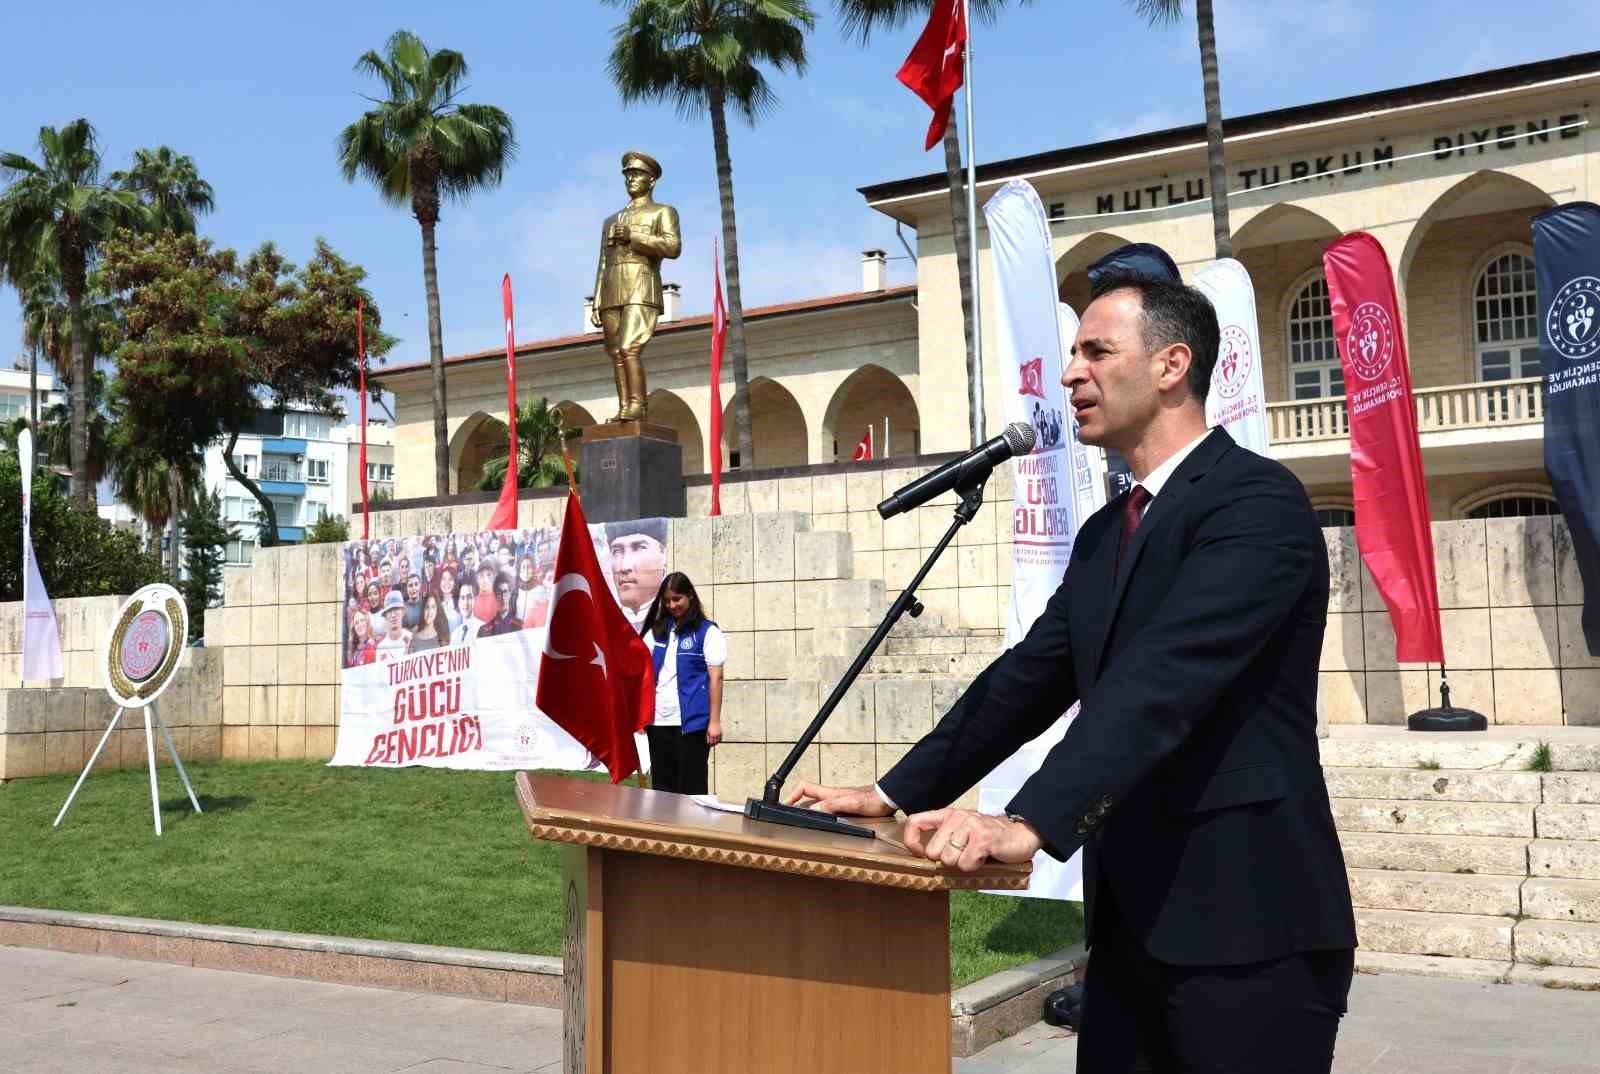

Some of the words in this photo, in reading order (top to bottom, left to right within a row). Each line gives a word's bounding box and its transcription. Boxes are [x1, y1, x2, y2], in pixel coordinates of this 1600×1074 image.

[1050, 202, 1065, 223] E
[1097, 178, 1204, 214] MUTLU
[393, 677, 461, 724] GÜCÜ
